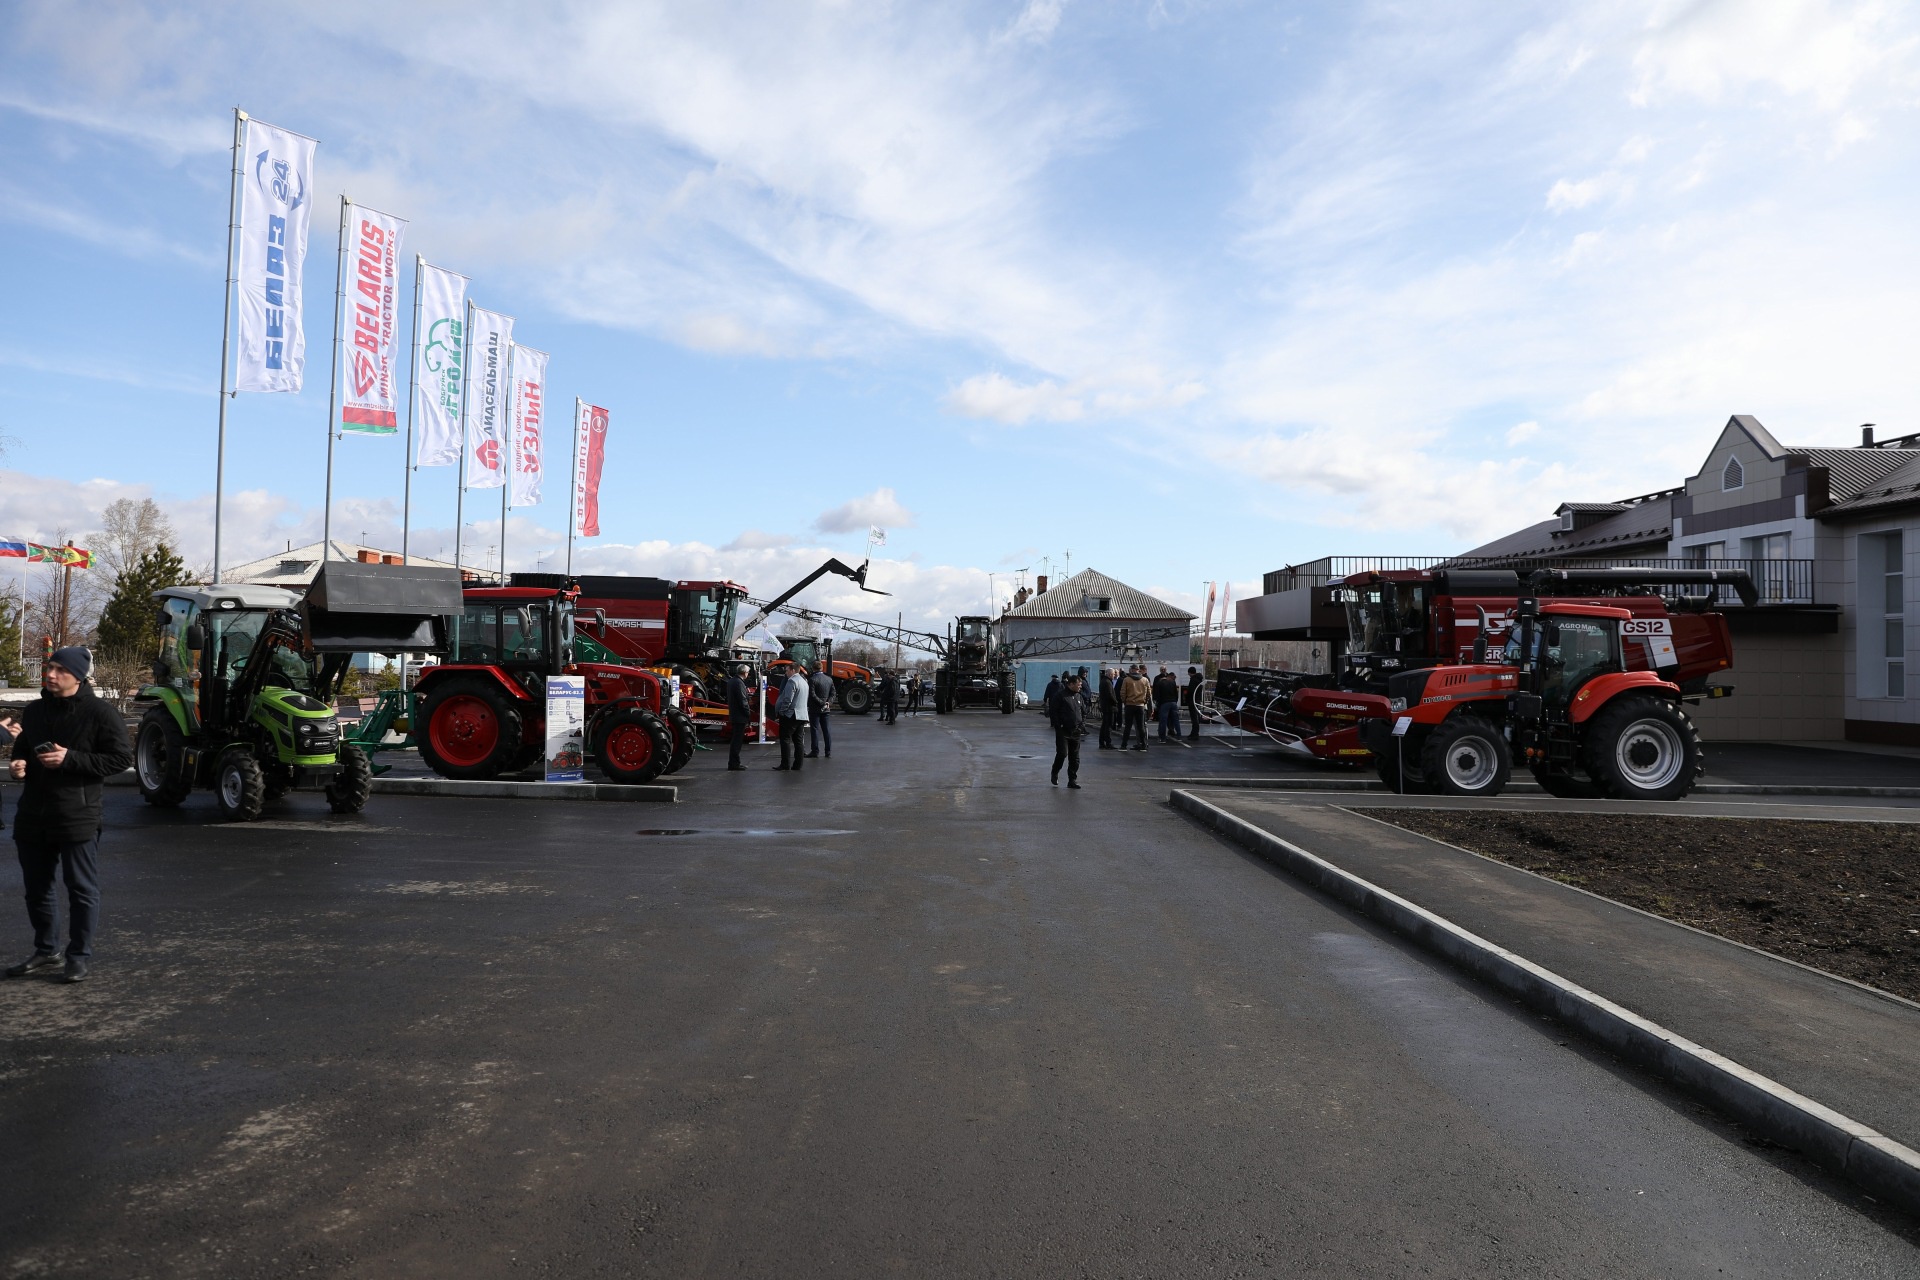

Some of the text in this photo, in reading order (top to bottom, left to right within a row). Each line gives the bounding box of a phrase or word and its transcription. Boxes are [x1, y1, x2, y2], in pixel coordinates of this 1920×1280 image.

[266, 158, 292, 370] БЕЛАЗ 24
[354, 219, 385, 355] BELARUS
[380, 229, 395, 399] MINSK TRACTOR WORKS
[445, 318, 463, 421] АГРОМАШ
[486, 331, 499, 437] ЛИДСЕЛЬМАШ
[577, 408, 591, 531] ГОМСЕЛЬМАШ
[1623, 621, 1664, 633] GS12
[1326, 702, 1368, 711] GOMSELMASH
